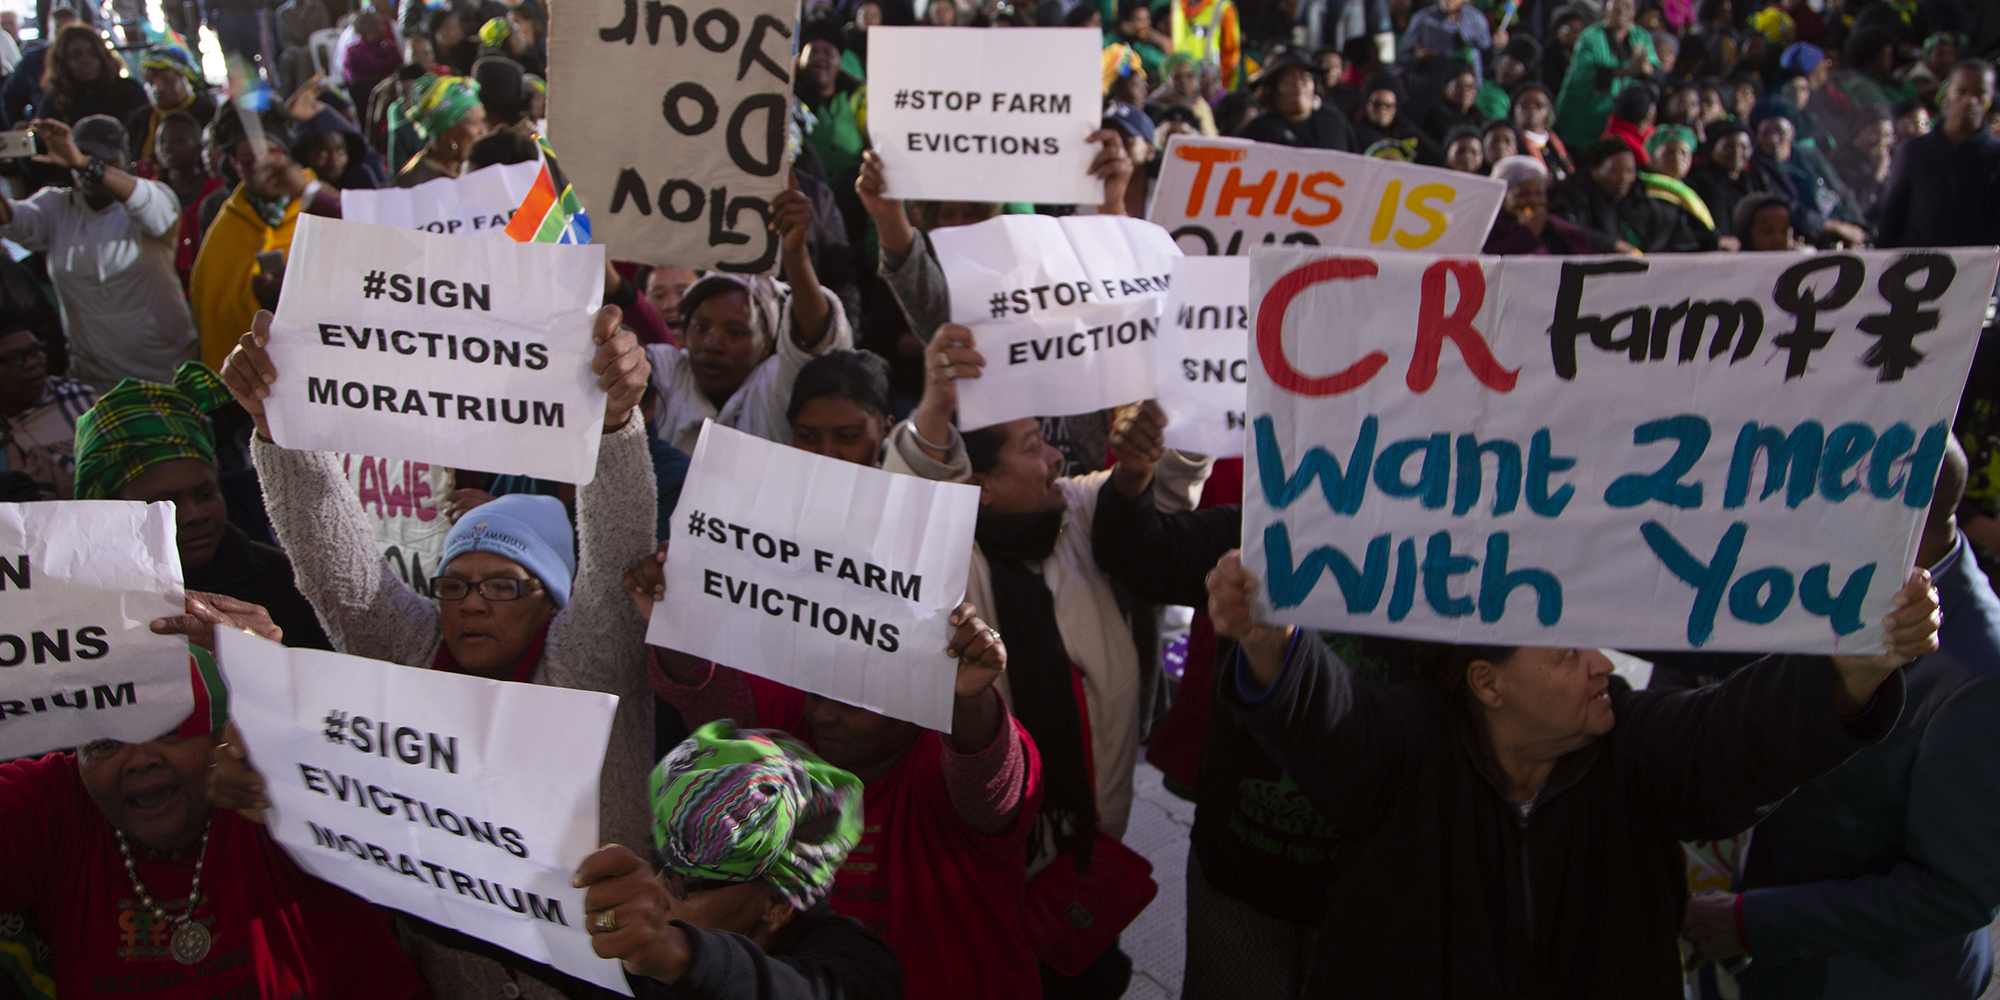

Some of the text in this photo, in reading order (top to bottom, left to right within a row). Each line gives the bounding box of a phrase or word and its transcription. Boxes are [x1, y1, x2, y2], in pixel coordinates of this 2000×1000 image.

[662, 81, 786, 177] Do
[894, 89, 1071, 114] #STOP FARM
[907, 132, 1060, 155] EVICTIONS
[1175, 144, 1456, 250] THIS IS
[363, 269, 491, 312] #SIGN
[989, 273, 1171, 318] #STOP FARM
[1546, 259, 1764, 382] Farm
[317, 322, 549, 371] EVICTIONS
[307, 376, 565, 428] MORATRIUM
[1253, 411, 1948, 519] Want 2 meet
[687, 509, 923, 603] #STOP FARM
[1639, 519, 1878, 648] You
[703, 568, 900, 654] EVICTIONS
[322, 708, 460, 775] #SIGN
[297, 762, 531, 858] EVICTIONS
[305, 820, 571, 928] MORATRIUM
[193, 946, 250, 982] JOBS
